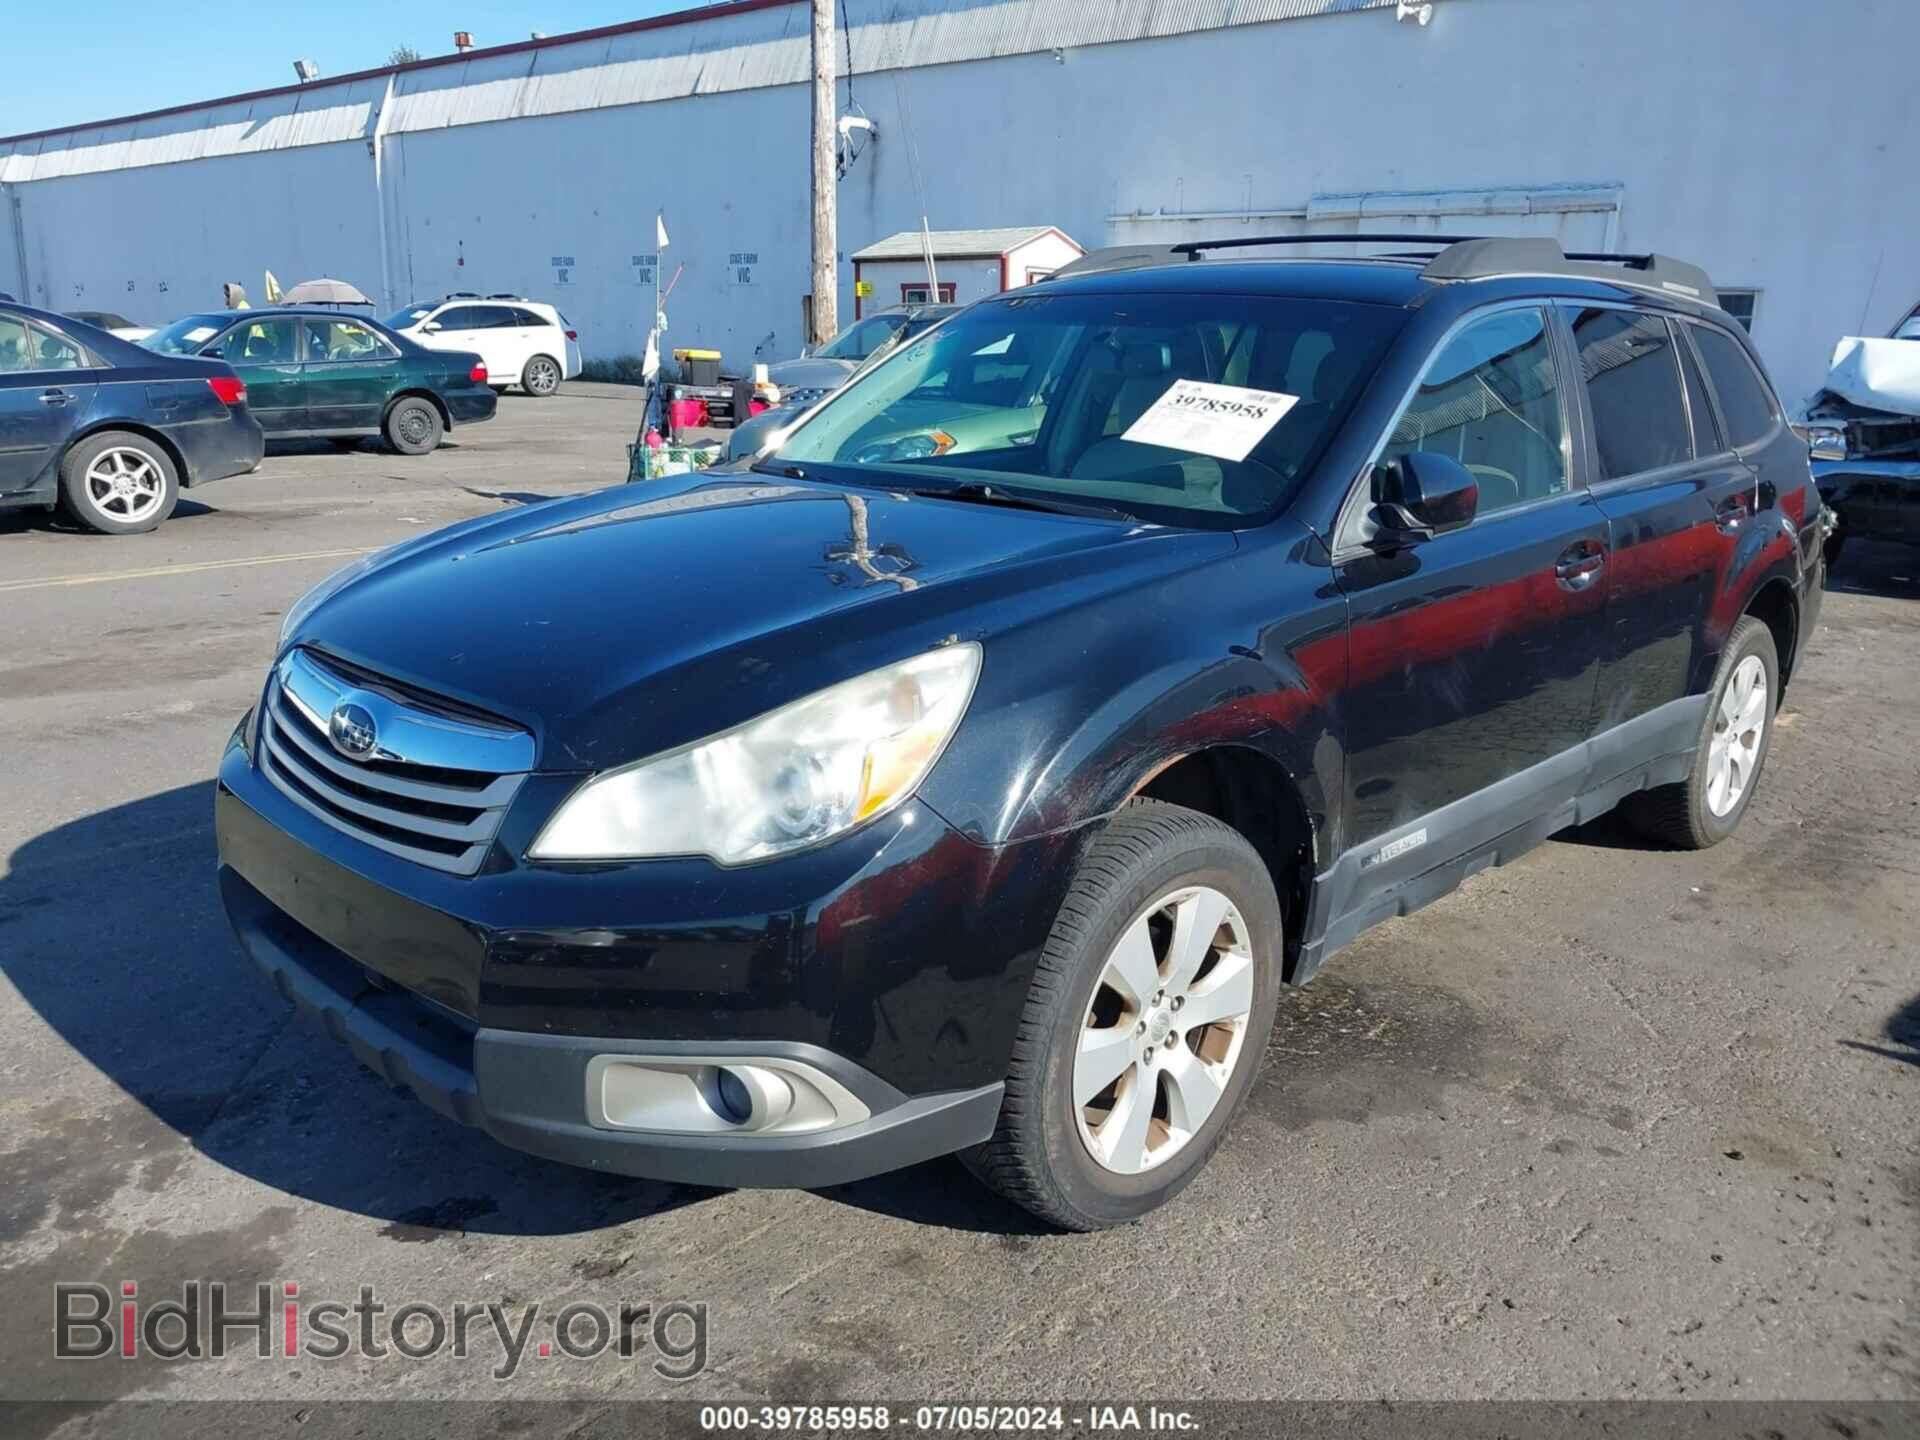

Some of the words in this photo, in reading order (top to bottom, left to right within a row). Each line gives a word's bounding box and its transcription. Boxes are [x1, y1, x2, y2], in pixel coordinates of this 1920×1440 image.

[729, 252, 743, 265] STATE
[557, 268, 569, 283] VIC
[639, 267, 652, 284] VIC
[736, 266, 751, 283] VIC
[1168, 393, 1268, 420] 39785958
